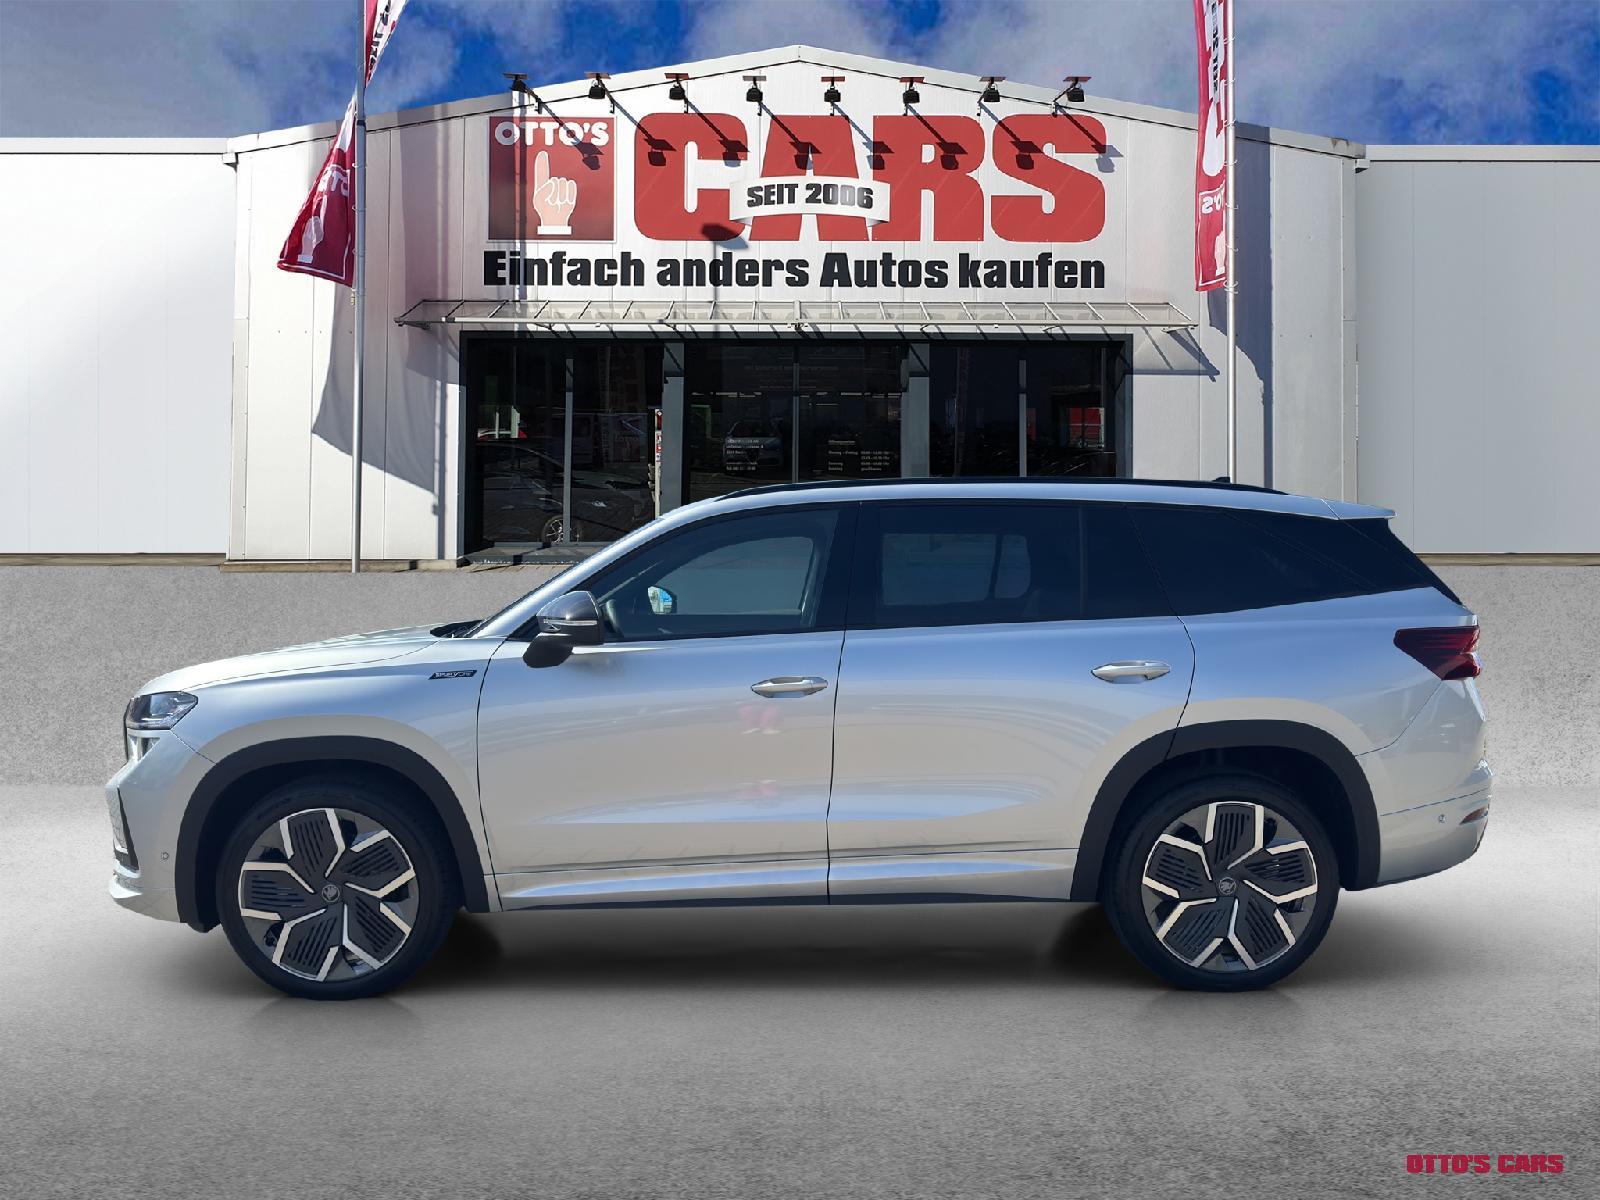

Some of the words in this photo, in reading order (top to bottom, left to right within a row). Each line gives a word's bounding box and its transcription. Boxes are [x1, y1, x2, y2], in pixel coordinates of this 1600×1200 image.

[494, 121, 610, 146] OTTO'S
[634, 112, 1107, 243] CARS
[747, 183, 798, 208] SEIT
[805, 183, 874, 210] 2006
[483, 250, 645, 289] Einfach
[656, 251, 807, 288] anders
[819, 252, 949, 289] Autos
[958, 252, 1105, 289] kaufen
